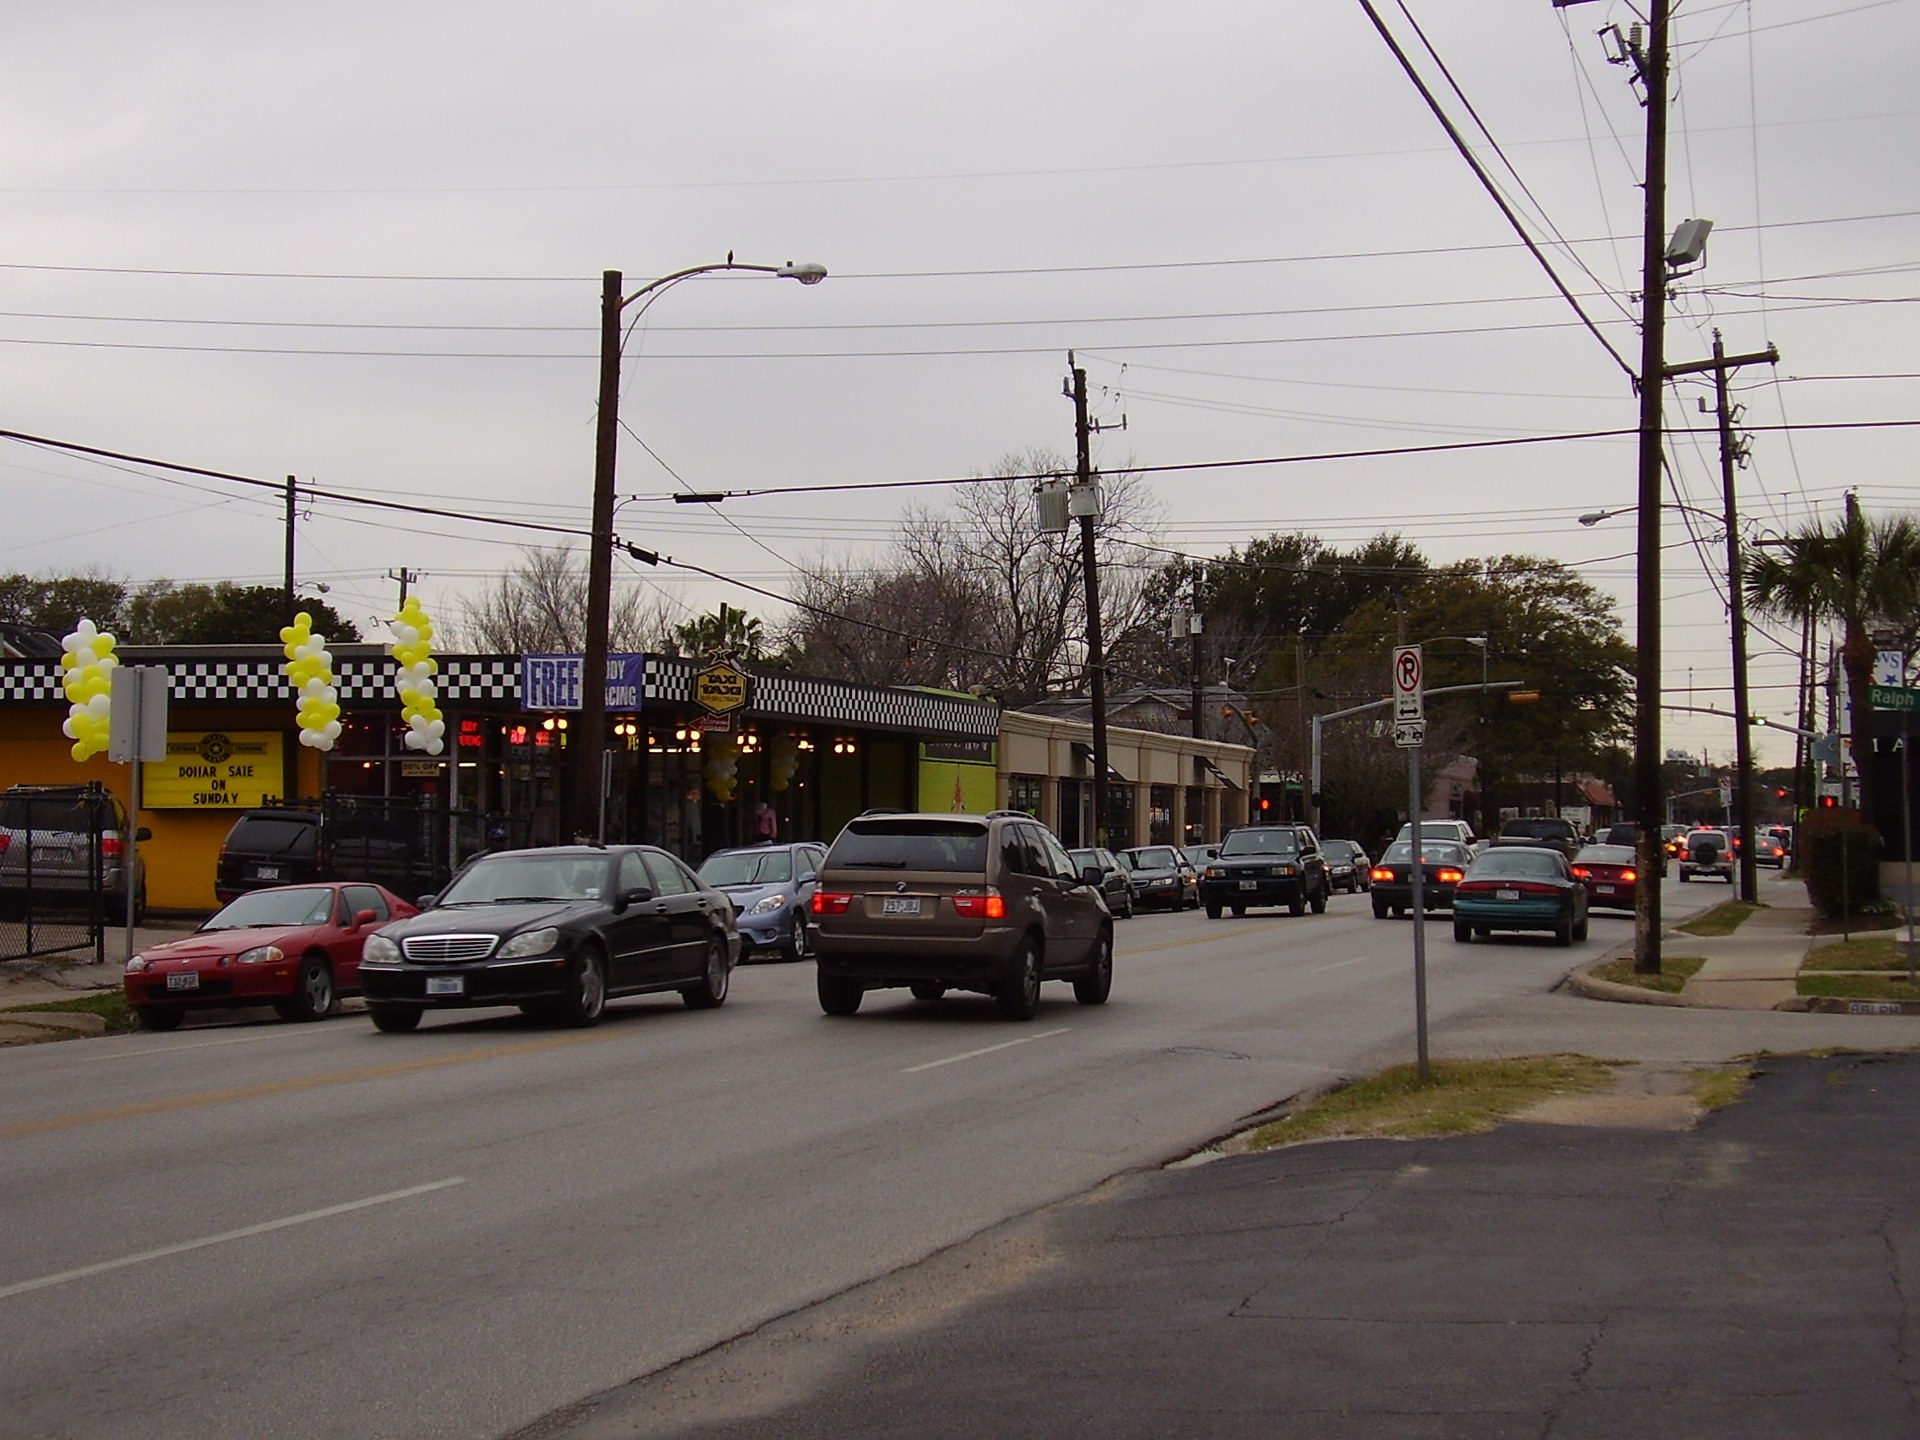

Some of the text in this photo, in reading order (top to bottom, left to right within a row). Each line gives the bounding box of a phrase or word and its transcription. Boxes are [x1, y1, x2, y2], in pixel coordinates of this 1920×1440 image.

[529, 660, 579, 706] FREE
[1871, 688, 1915, 706] Ralph
[211, 779, 226, 790] ON
[193, 793, 238, 805] SUNDAY
